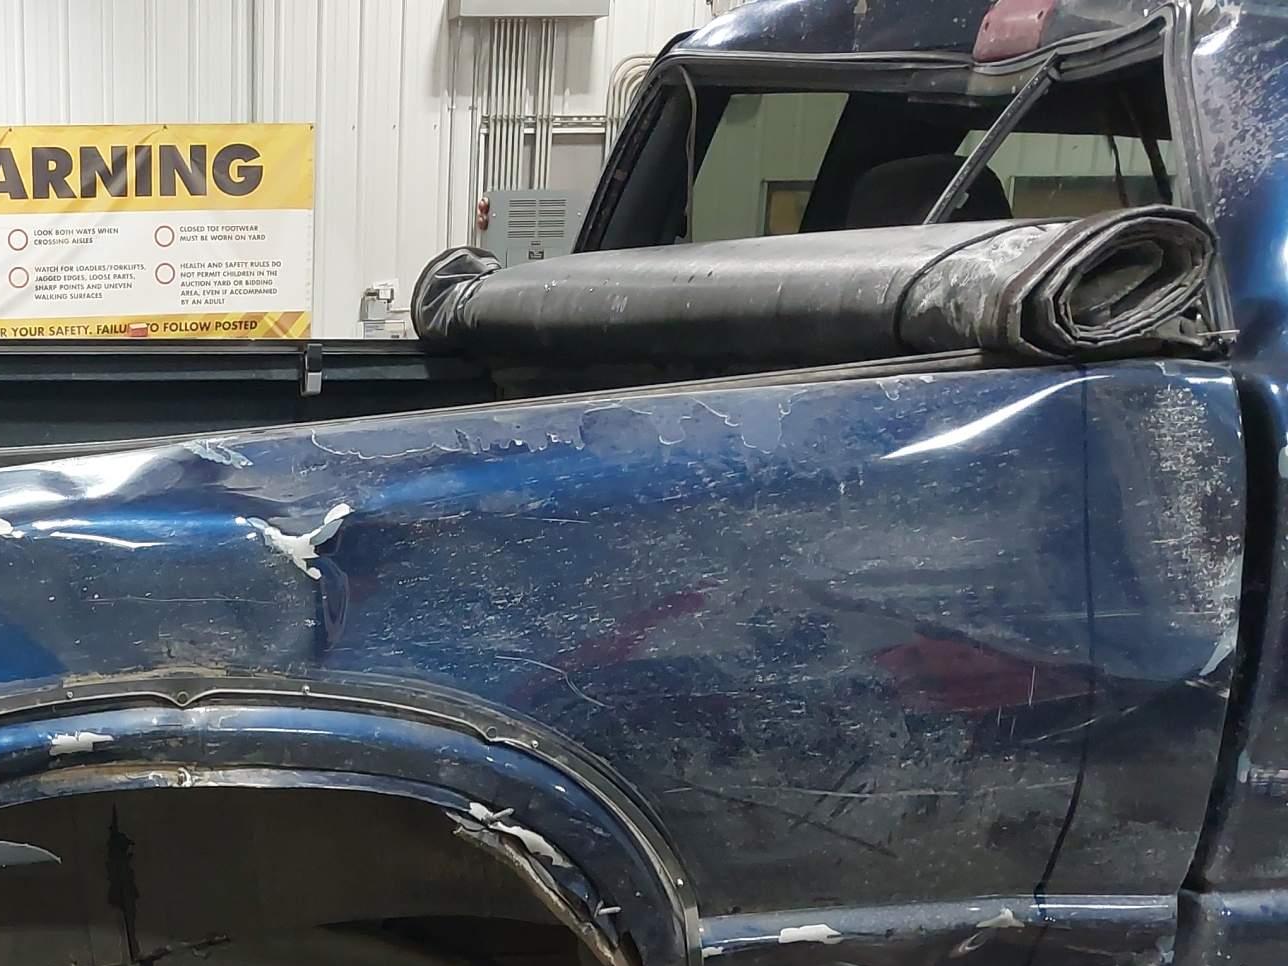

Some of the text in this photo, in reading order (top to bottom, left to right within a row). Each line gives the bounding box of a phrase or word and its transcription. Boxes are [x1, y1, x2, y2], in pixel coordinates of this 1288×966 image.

[11, 327, 44, 336] YOUR
[49, 325, 92, 336] SAFETY.
[163, 321, 211, 332] FOLLOW
[215, 320, 258, 331] POSTED
